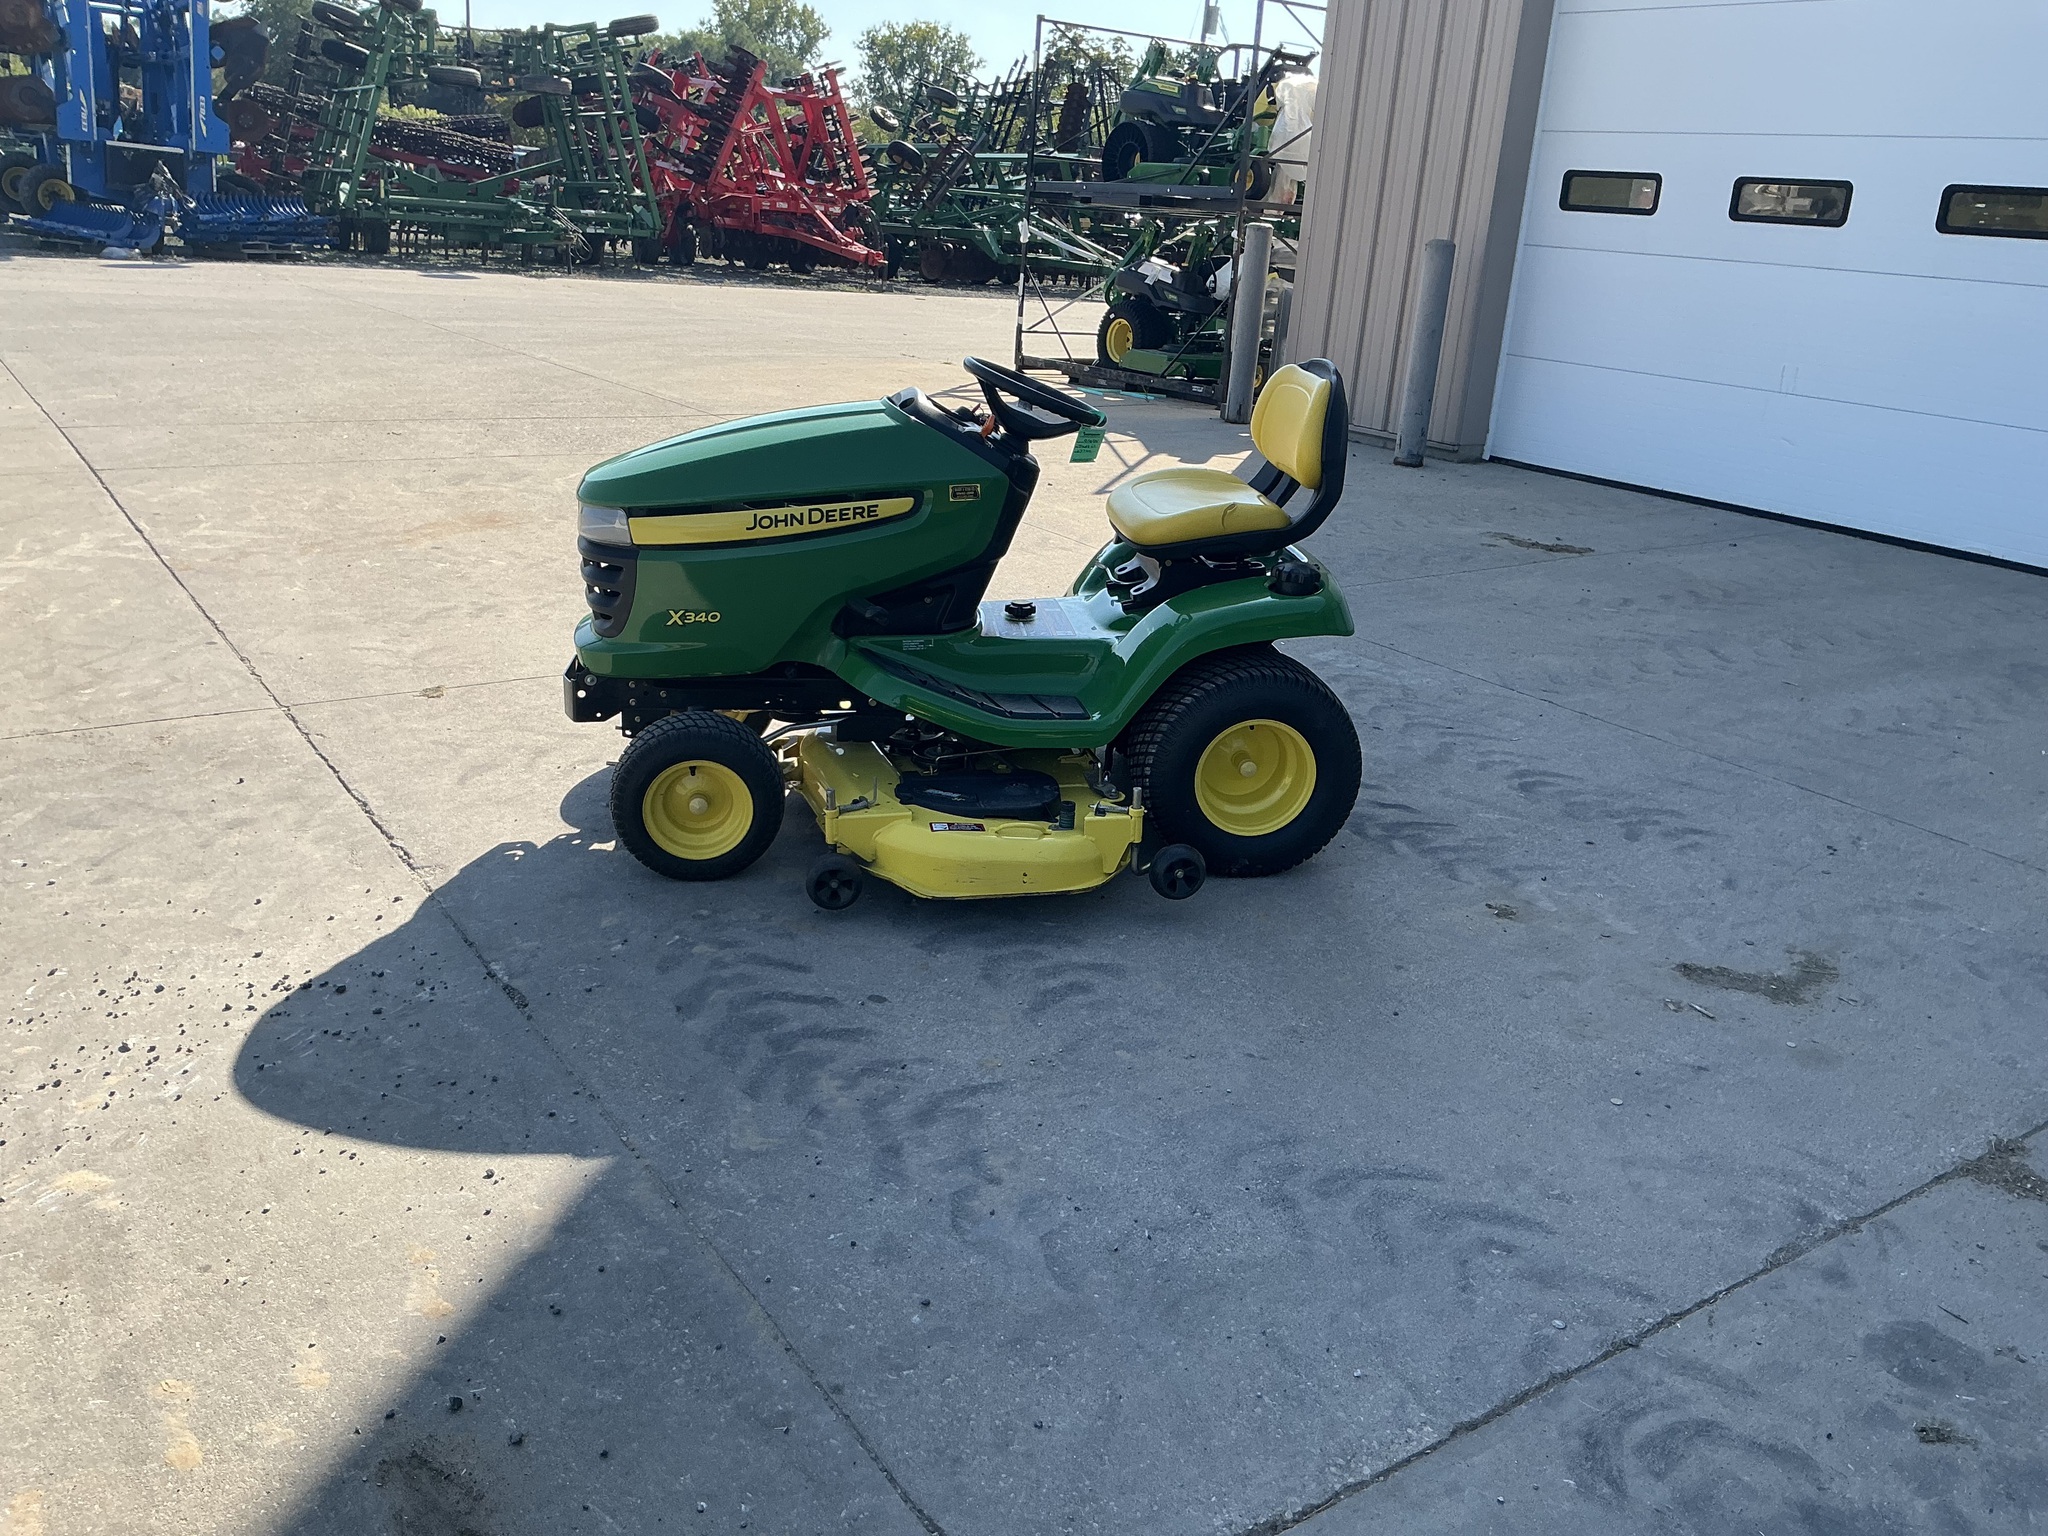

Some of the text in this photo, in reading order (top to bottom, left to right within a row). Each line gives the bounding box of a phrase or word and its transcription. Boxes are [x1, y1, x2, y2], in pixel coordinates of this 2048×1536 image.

[746, 503, 879, 531] JOHN DEERE
[665, 609, 721, 626] X340
